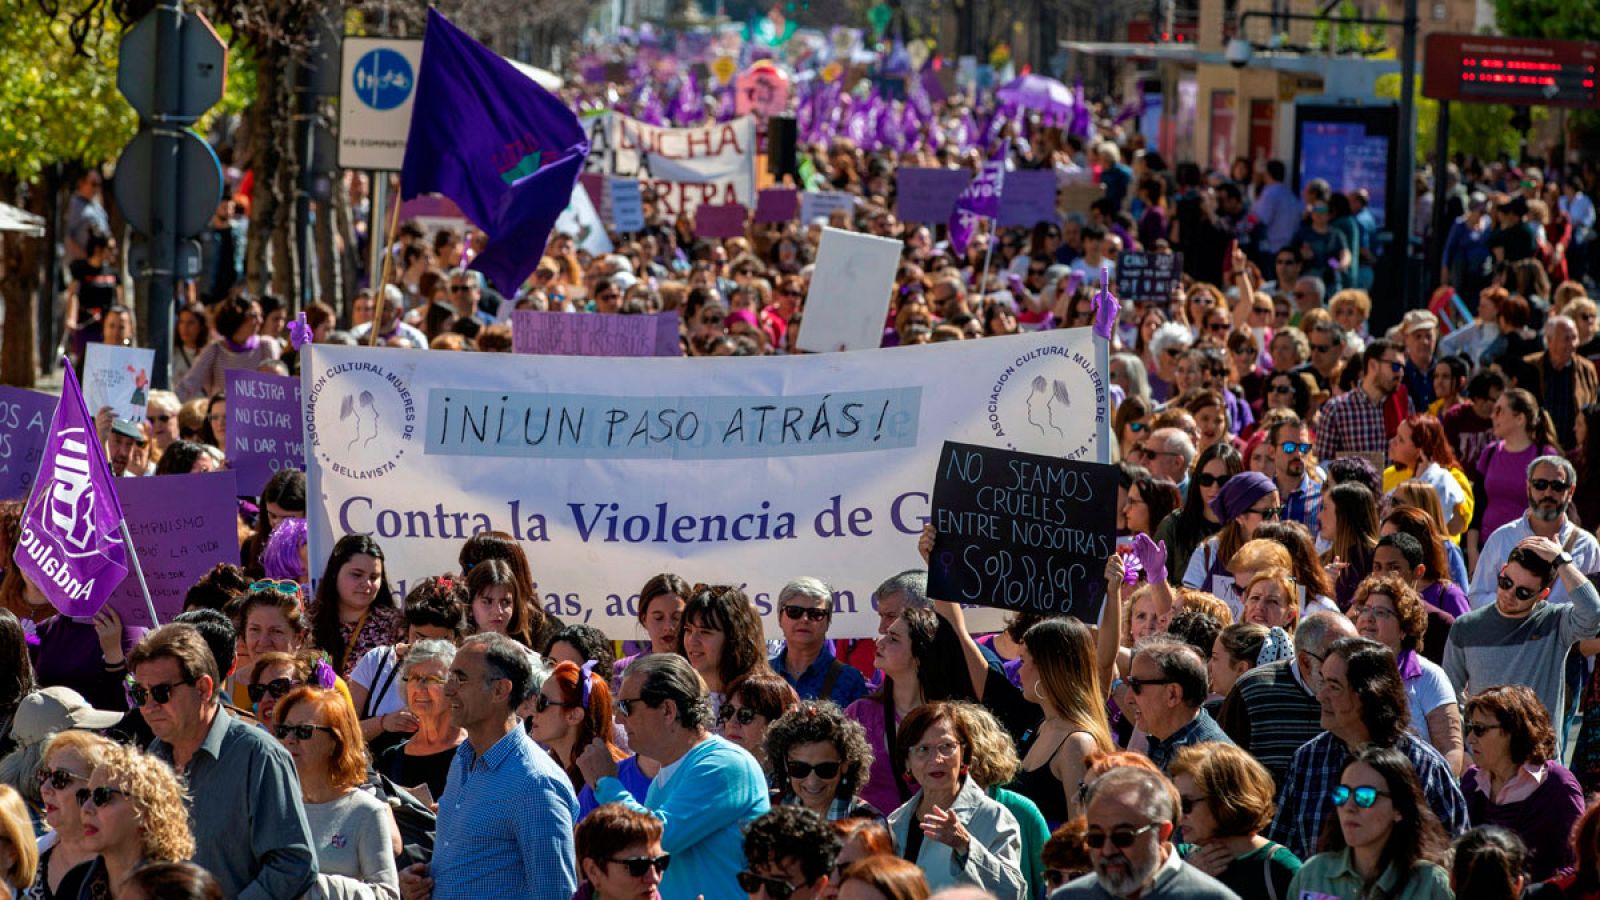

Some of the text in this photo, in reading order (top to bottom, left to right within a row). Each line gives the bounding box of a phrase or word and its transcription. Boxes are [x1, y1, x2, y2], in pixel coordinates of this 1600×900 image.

[619, 119, 744, 159] LUCHA
[235, 379, 286, 400] NUESTRA
[305, 376, 327, 446] ASOCIACION
[326, 362, 384, 378] CULTURAL
[386, 372, 416, 421] MUJERES
[402, 425, 415, 441] DE
[988, 346, 1105, 437] ASOCIACION CULTURAL MUJERES DE
[26, 410, 45, 433] A
[235, 407, 292, 430] NO ESTAR
[605, 407, 700, 447] PASO
[235, 436, 249, 452] NI
[253, 438, 277, 454] DAR
[332, 460, 397, 480] BELLAVISTA
[946, 449, 1093, 501] NO SEAMOS
[339, 495, 493, 539] Contra
[507, 500, 551, 541] la
[566, 501, 798, 543] Violencia
[814, 494, 873, 538] de
[976, 486, 1067, 525] CRUELES
[937, 508, 1109, 560] ENTRE NOSOTRAS
